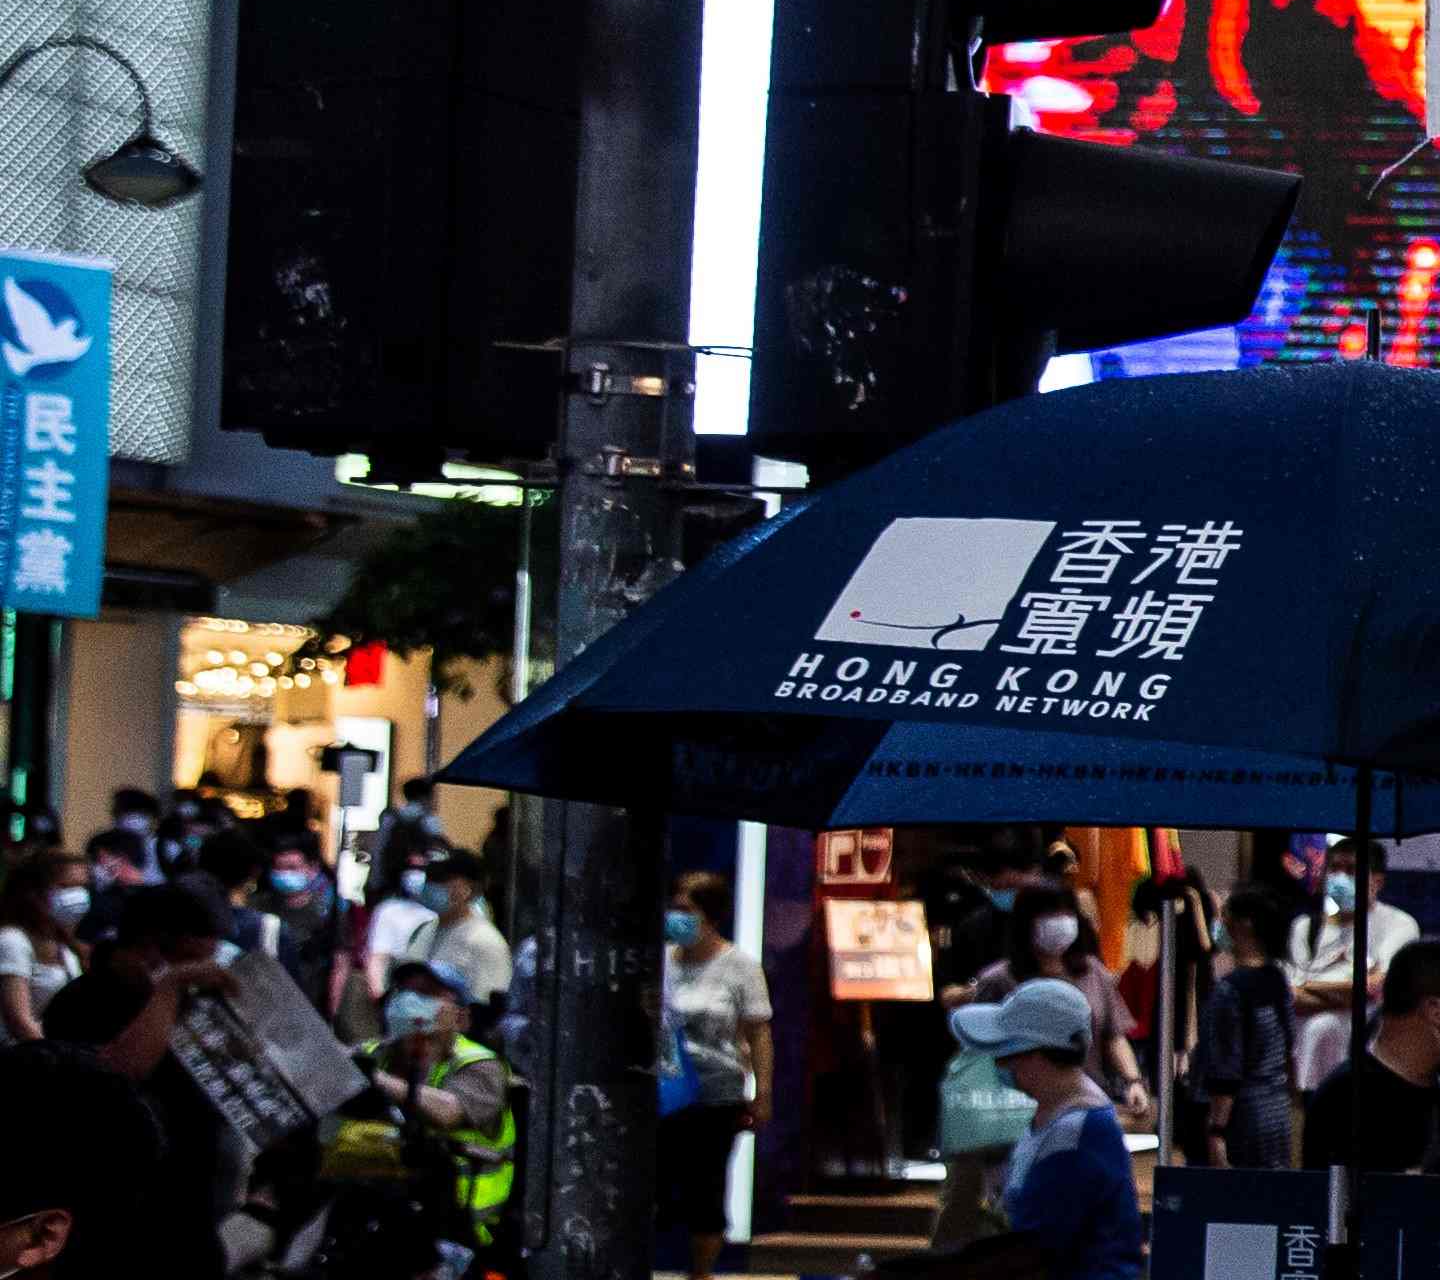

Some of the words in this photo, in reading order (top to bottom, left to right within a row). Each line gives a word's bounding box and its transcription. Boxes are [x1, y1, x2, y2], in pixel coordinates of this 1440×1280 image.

[1049, 520, 1245, 587] 香港
[1001, 588, 1215, 663] 寬頻
[774, 680, 979, 711] BROADBAND
[995, 694, 1157, 722] NETWORK
[787, 653, 963, 690] HONG
[996, 665, 1172, 702] KONG
